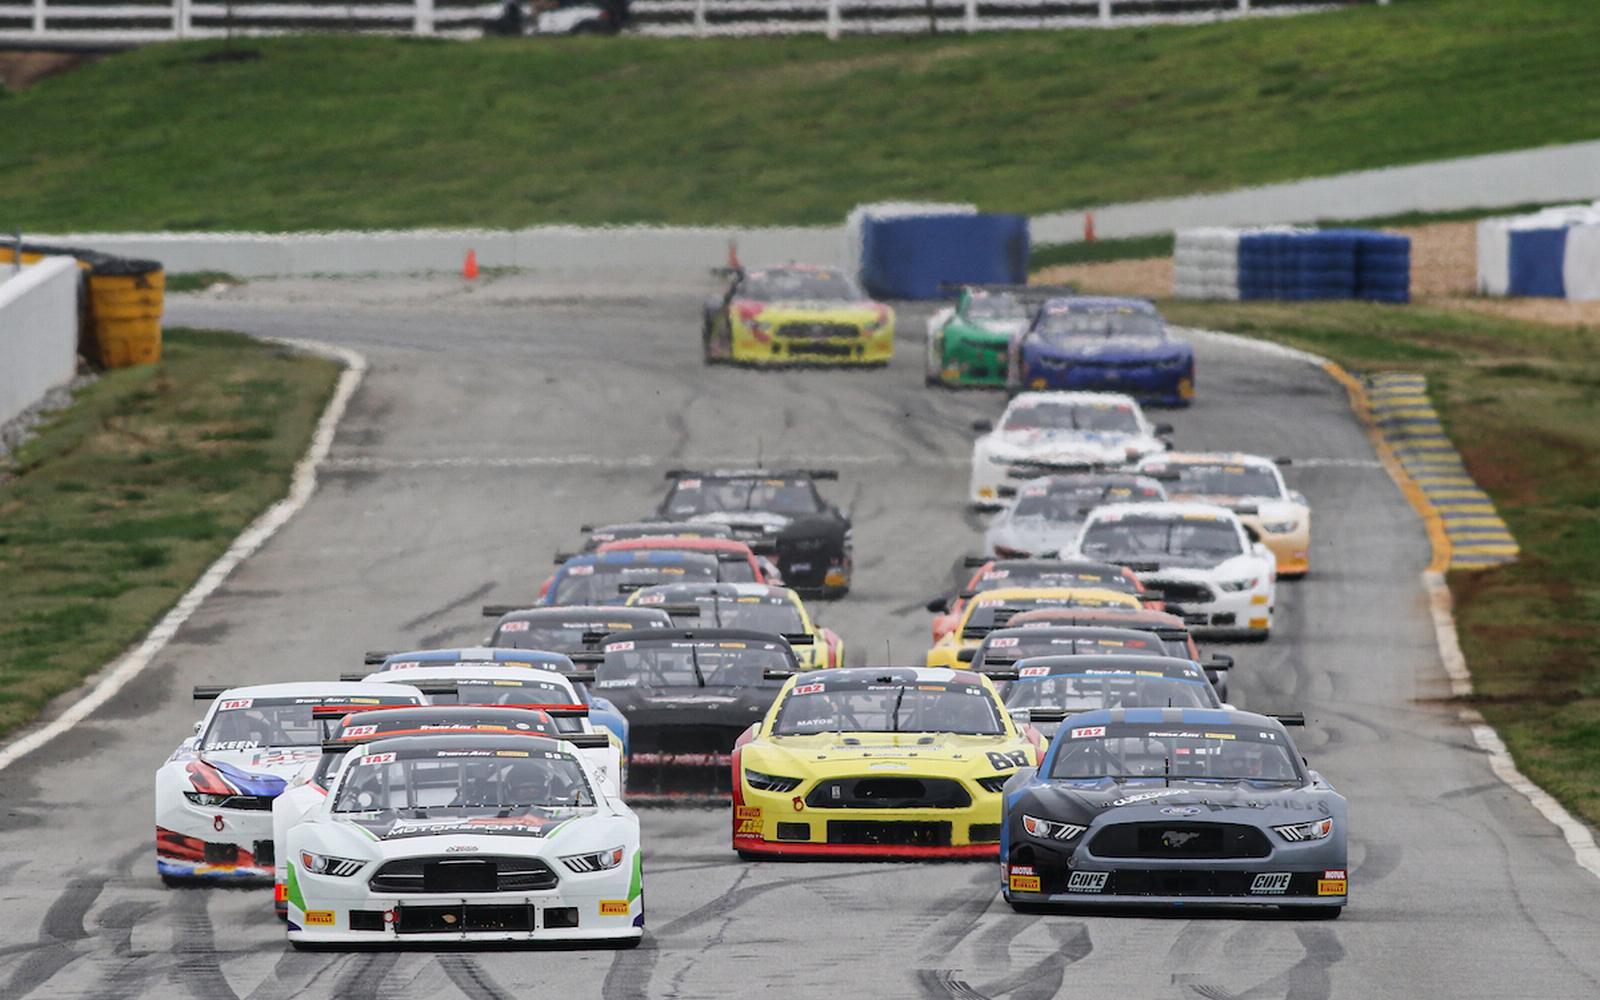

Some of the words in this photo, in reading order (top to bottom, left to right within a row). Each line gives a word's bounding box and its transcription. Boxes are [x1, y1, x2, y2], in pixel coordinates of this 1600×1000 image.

[794, 685, 823, 694] TA2
[223, 700, 250, 709] TA2
[797, 719, 833, 727] MATOS
[346, 726, 374, 736] TA2
[1076, 727, 1103, 736] TA2
[205, 741, 259, 751] SKEEN
[365, 754, 392, 764] TA2
[985, 749, 1031, 771] 88
[387, 823, 542, 836] MOTORSPORTS
